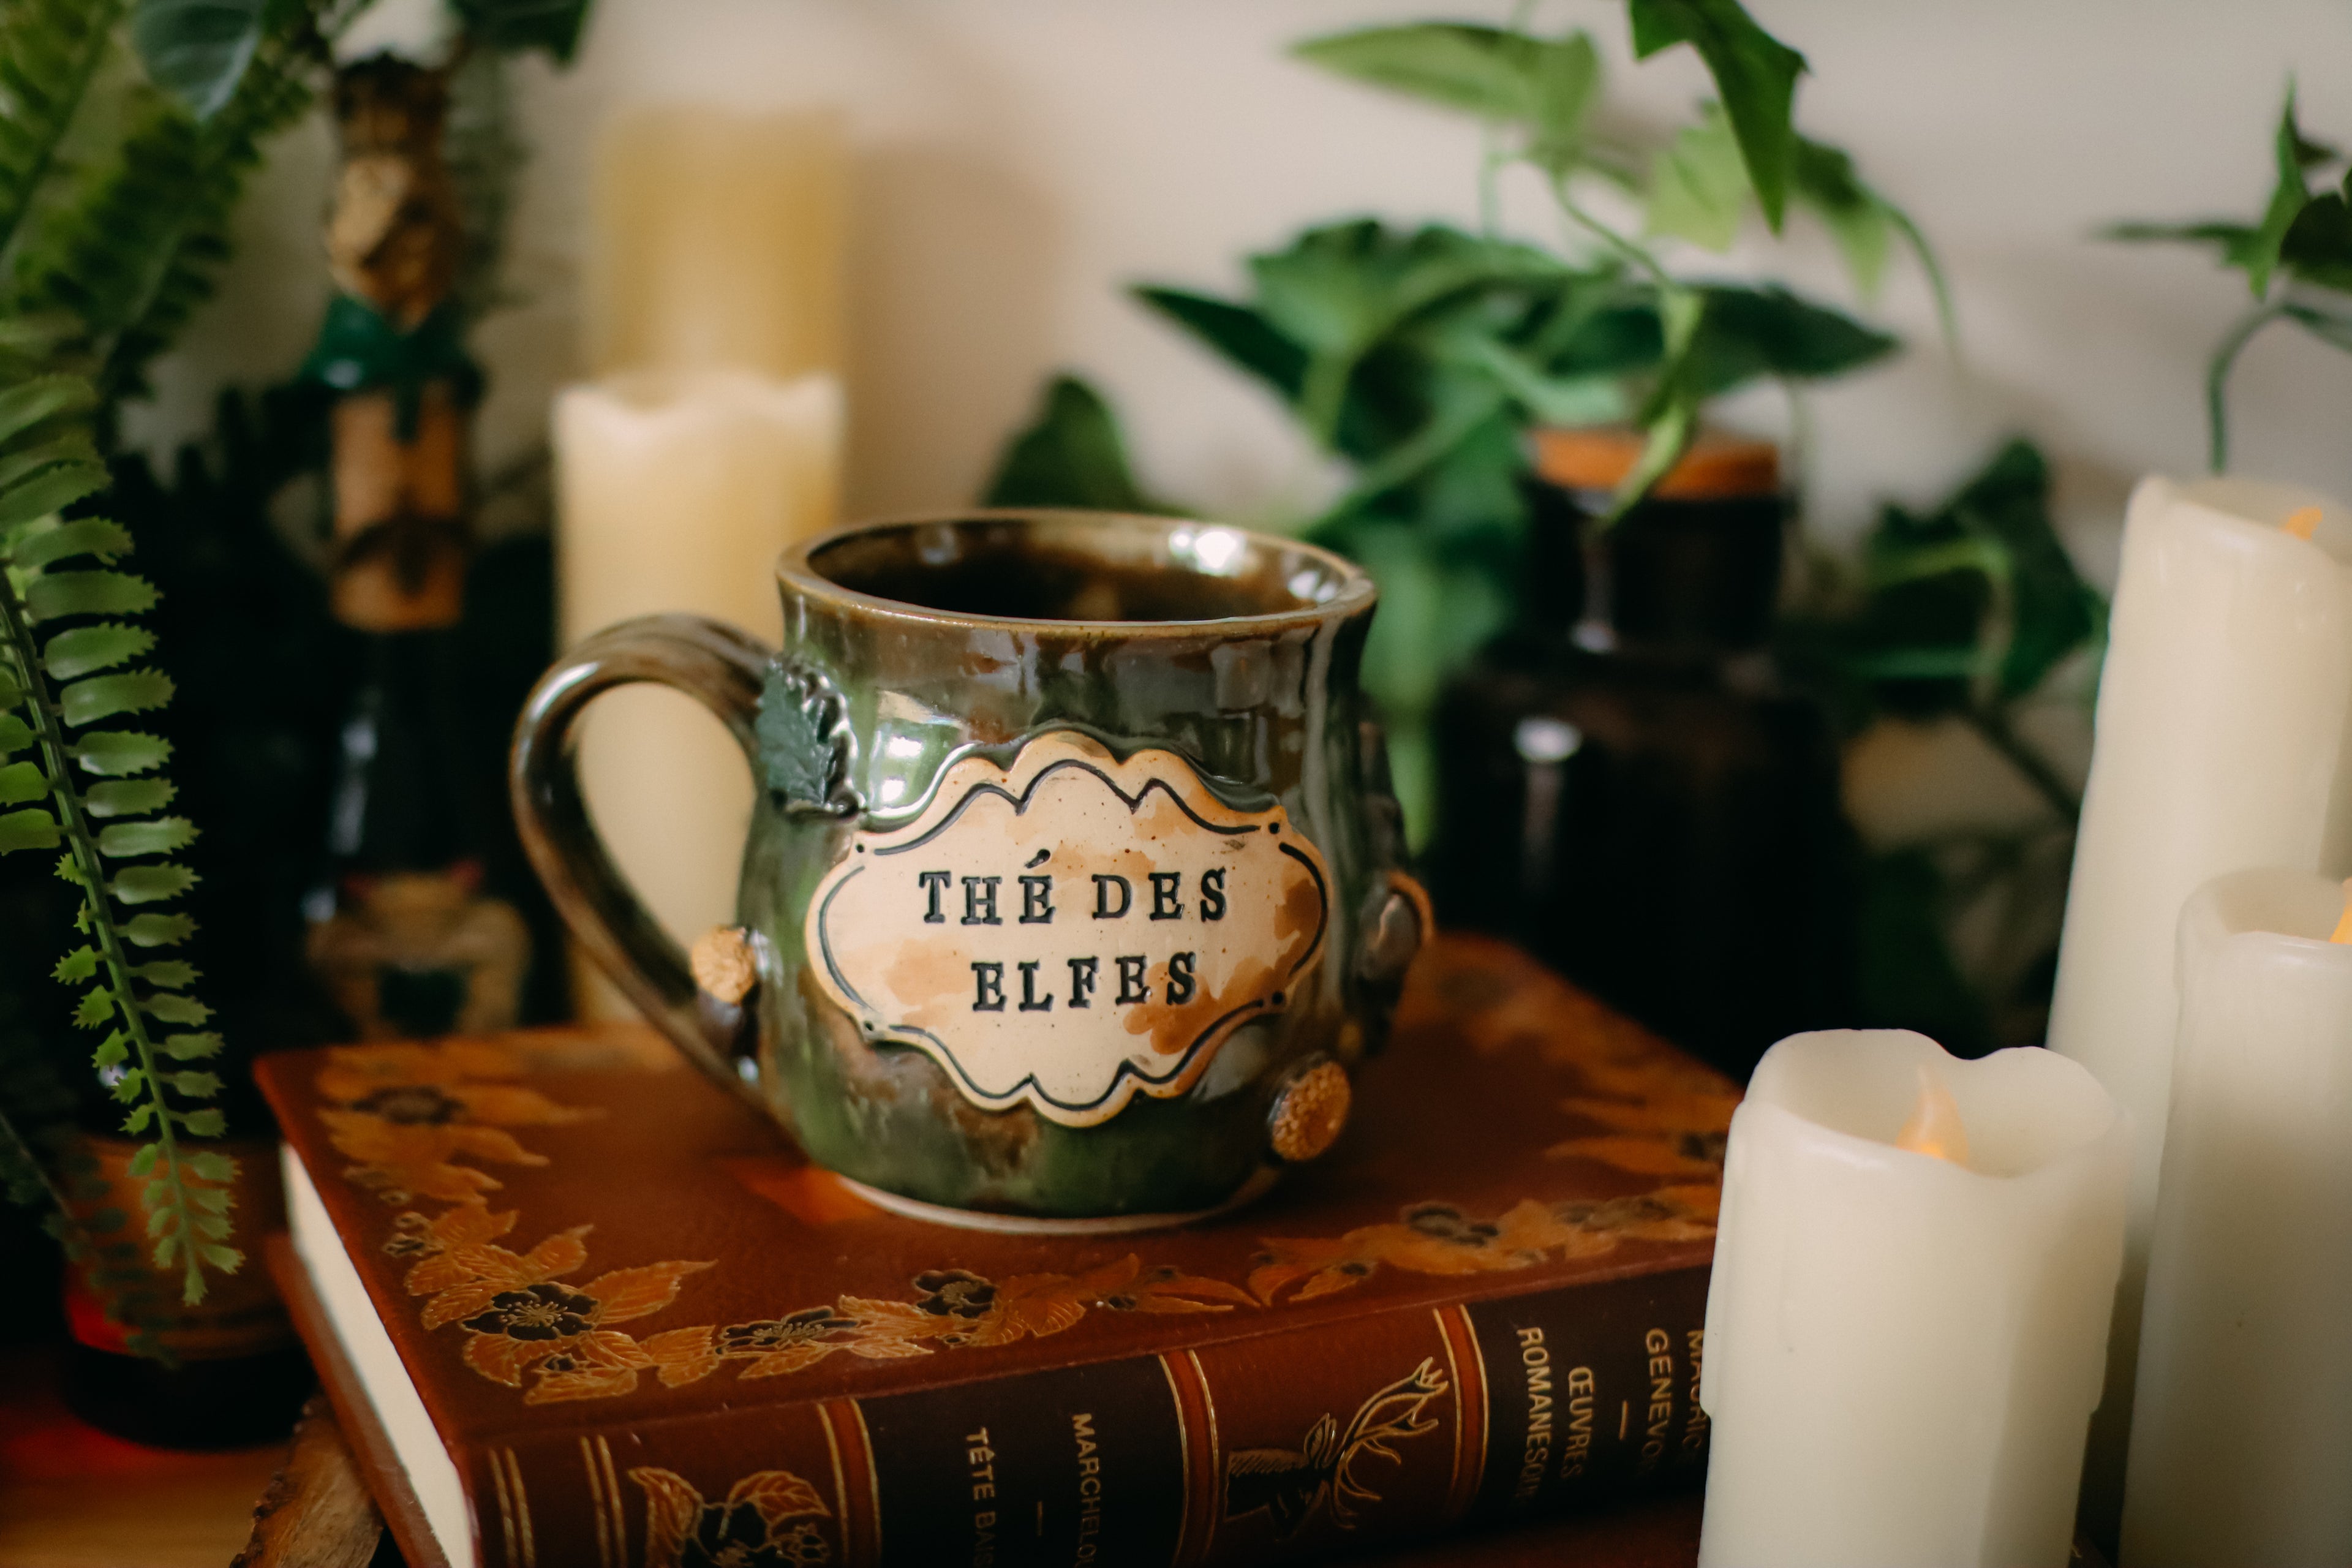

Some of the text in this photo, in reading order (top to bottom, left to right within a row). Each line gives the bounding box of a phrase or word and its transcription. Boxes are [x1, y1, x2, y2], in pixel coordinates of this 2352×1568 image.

[919, 849, 1227, 925] THÉ DES
[971, 951, 1197, 1012] ELFES
[1561, 1366, 1595, 1479] ŒUVRES
[1638, 1327, 1674, 1473] GENEVO
[966, 1427, 997, 1568] TÊTE BAIS
